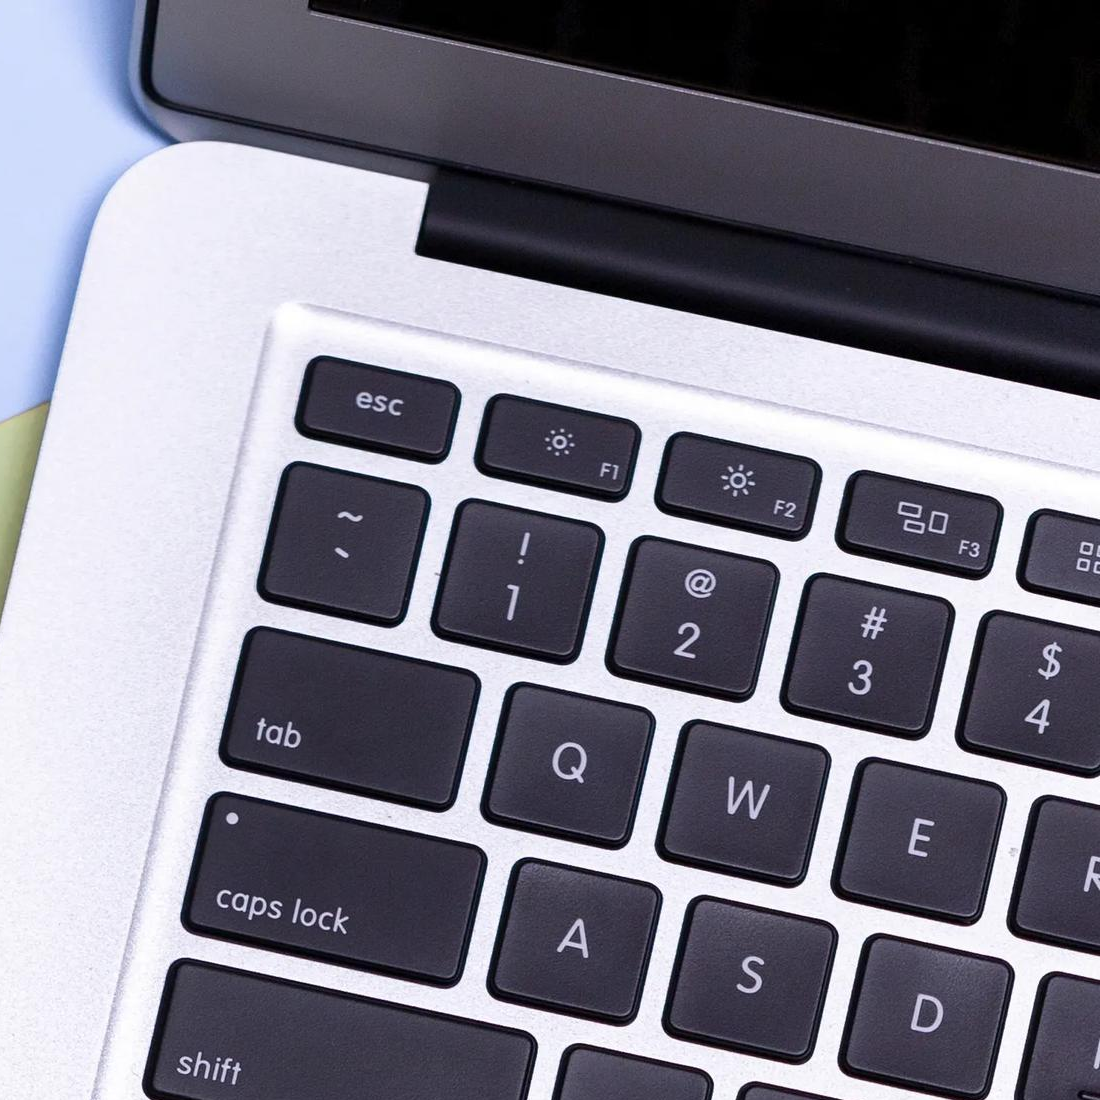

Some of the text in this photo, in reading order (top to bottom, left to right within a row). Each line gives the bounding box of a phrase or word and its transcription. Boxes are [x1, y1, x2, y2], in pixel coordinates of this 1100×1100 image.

[356, 391, 404, 416] esc
[599, 462, 619, 480] F1
[773, 499, 797, 519] F2
[517, 532, 531, 565] !
[958, 539, 980, 558] F3
[684, 568, 717, 599] @
[506, 584, 520, 621] 1
[673, 622, 701, 659] 2
[860, 606, 888, 640] #
[848, 659, 873, 695] 3
[1037, 641, 1063, 681] $
[256, 717, 302, 749] tab
[1024, 698, 1051, 735] 4
[552, 741, 588, 784] Q
[727, 775, 771, 820] W
[907, 817, 935, 858] E
[216, 889, 349, 935] caps lock
[556, 918, 589, 959] A
[736, 955, 765, 994] S
[910, 993, 944, 1033] D
[176, 1051, 242, 1085] shift
